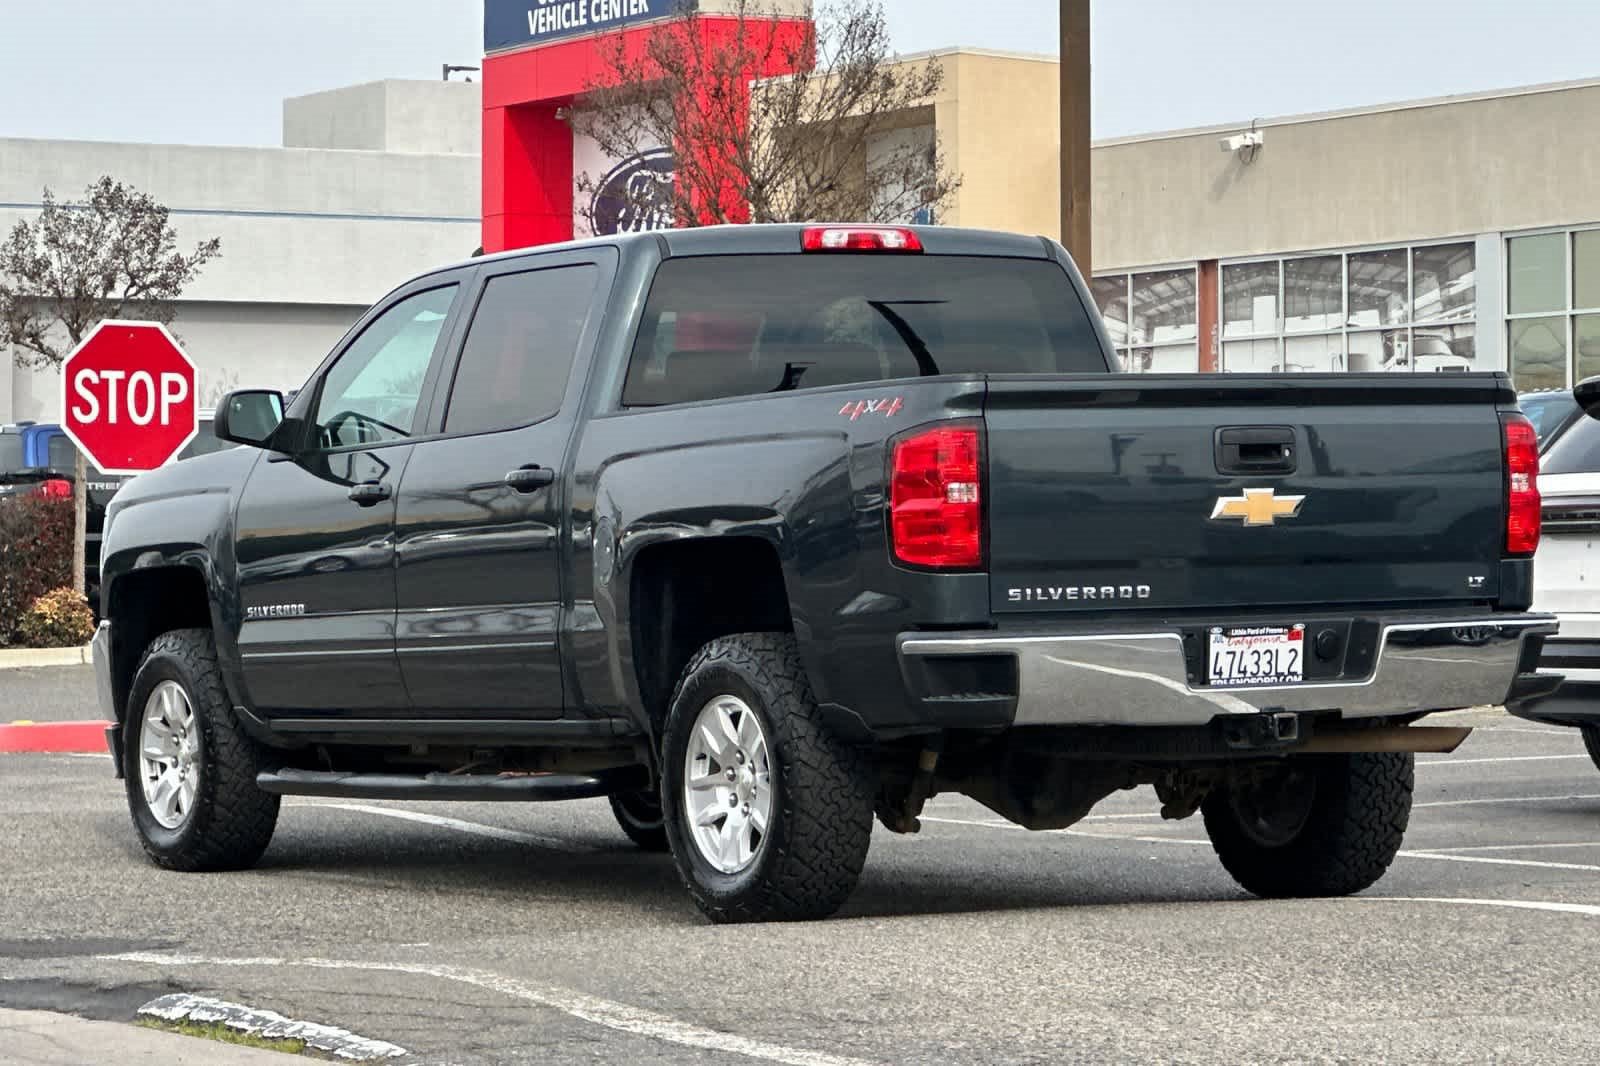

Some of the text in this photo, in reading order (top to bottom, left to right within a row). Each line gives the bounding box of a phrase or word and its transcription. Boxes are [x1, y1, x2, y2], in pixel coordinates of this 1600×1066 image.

[528, 0, 649, 35] VEHICLE CENTER
[71, 368, 188, 426] STOP
[1468, 575, 1485, 588] LT
[1008, 585, 1151, 601] SILVERADO
[247, 604, 304, 617] SILVERADO
[1227, 635, 1282, 649] California
[1212, 648, 1299, 679] 47433L2
